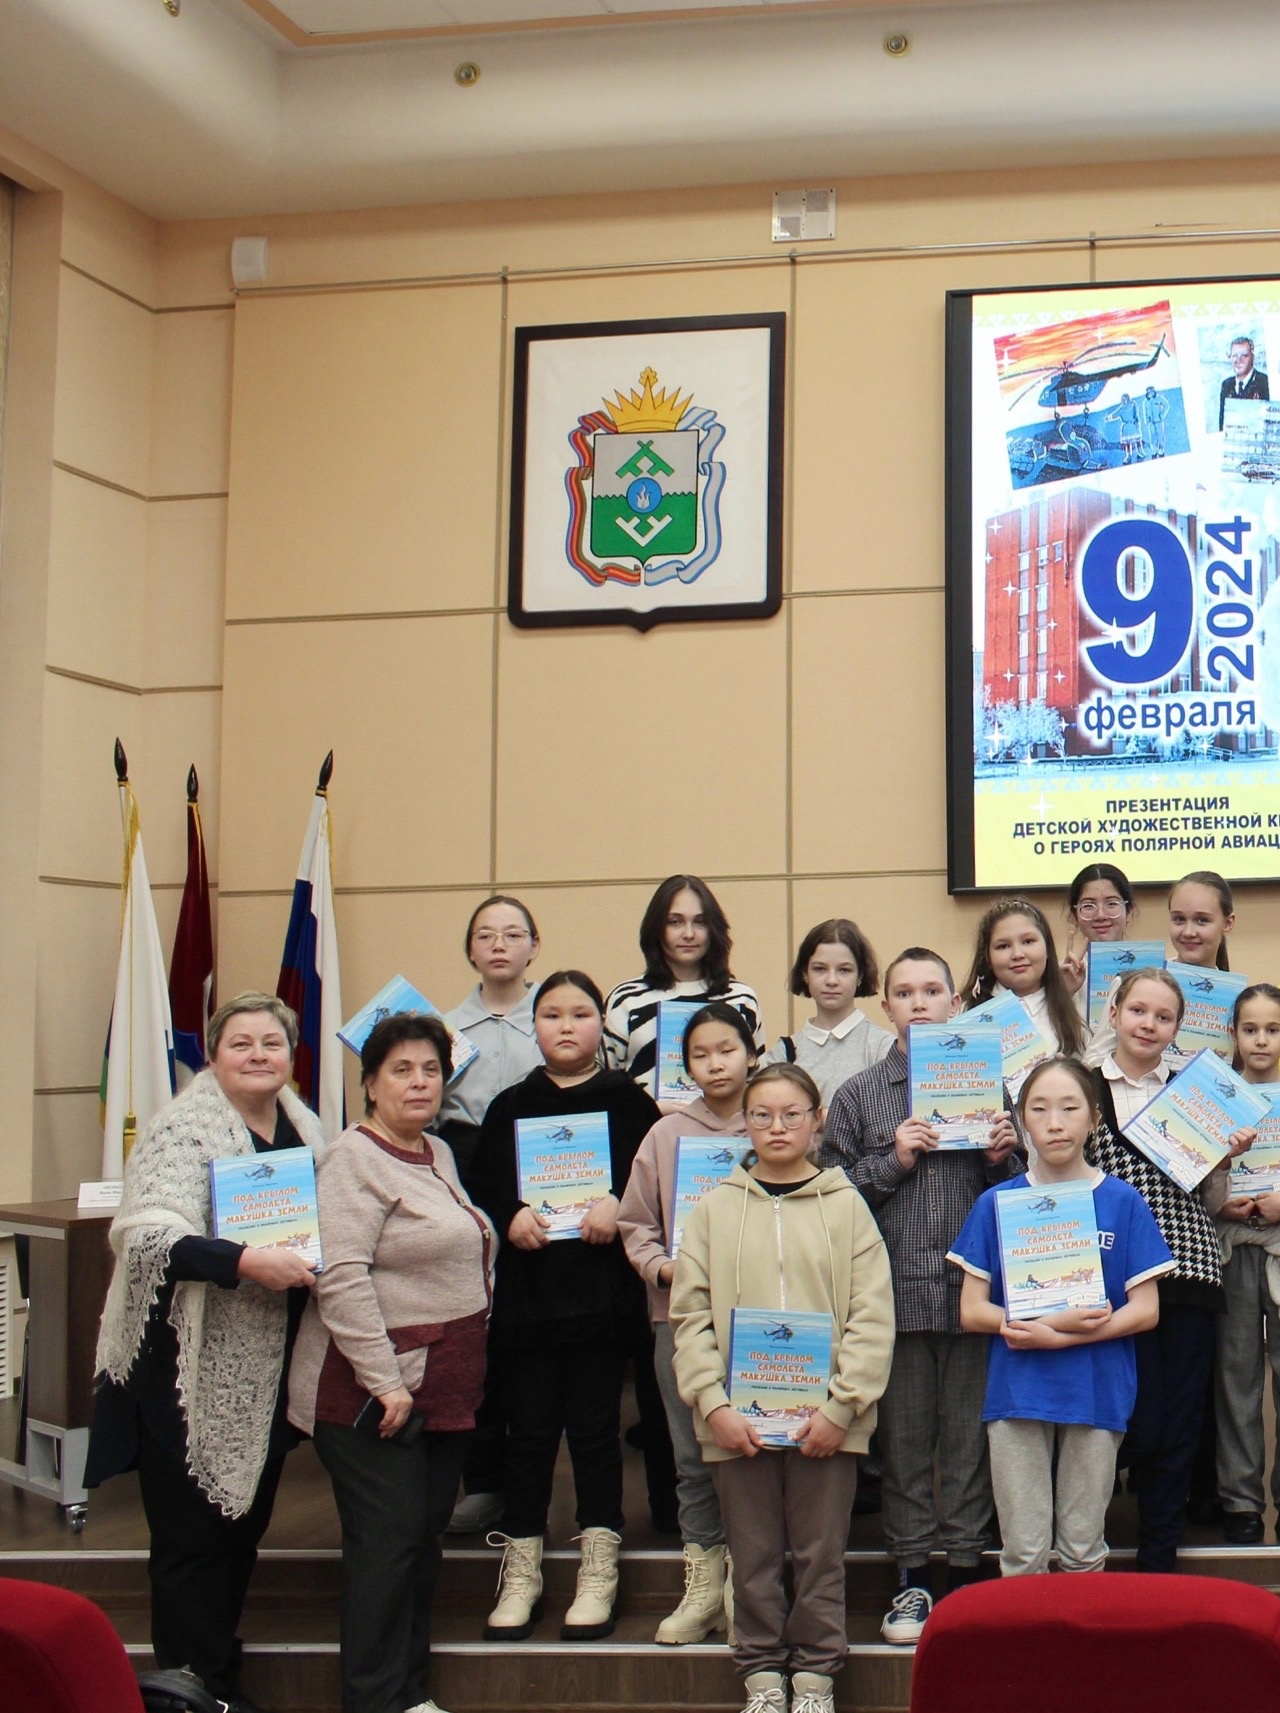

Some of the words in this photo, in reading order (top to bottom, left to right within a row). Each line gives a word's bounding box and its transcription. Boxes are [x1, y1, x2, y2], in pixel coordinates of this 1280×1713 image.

[1082, 520, 1194, 684] 9
[1204, 516, 1254, 681] 2024
[1084, 697, 1256, 739] февраля
[1106, 797, 1230, 813] ПРЕЗЕНТАЦИЯ
[1013, 818, 1092, 838] ДЕТСКОЙ
[1098, 812, 1262, 833] ХУДОЖЕСТВЕННОЙ
[1033, 842, 1045, 855] О
[1051, 838, 1116, 854] ГЕРОЯХ
[1121, 833, 1215, 851] ПОЛЯРНОЙ
